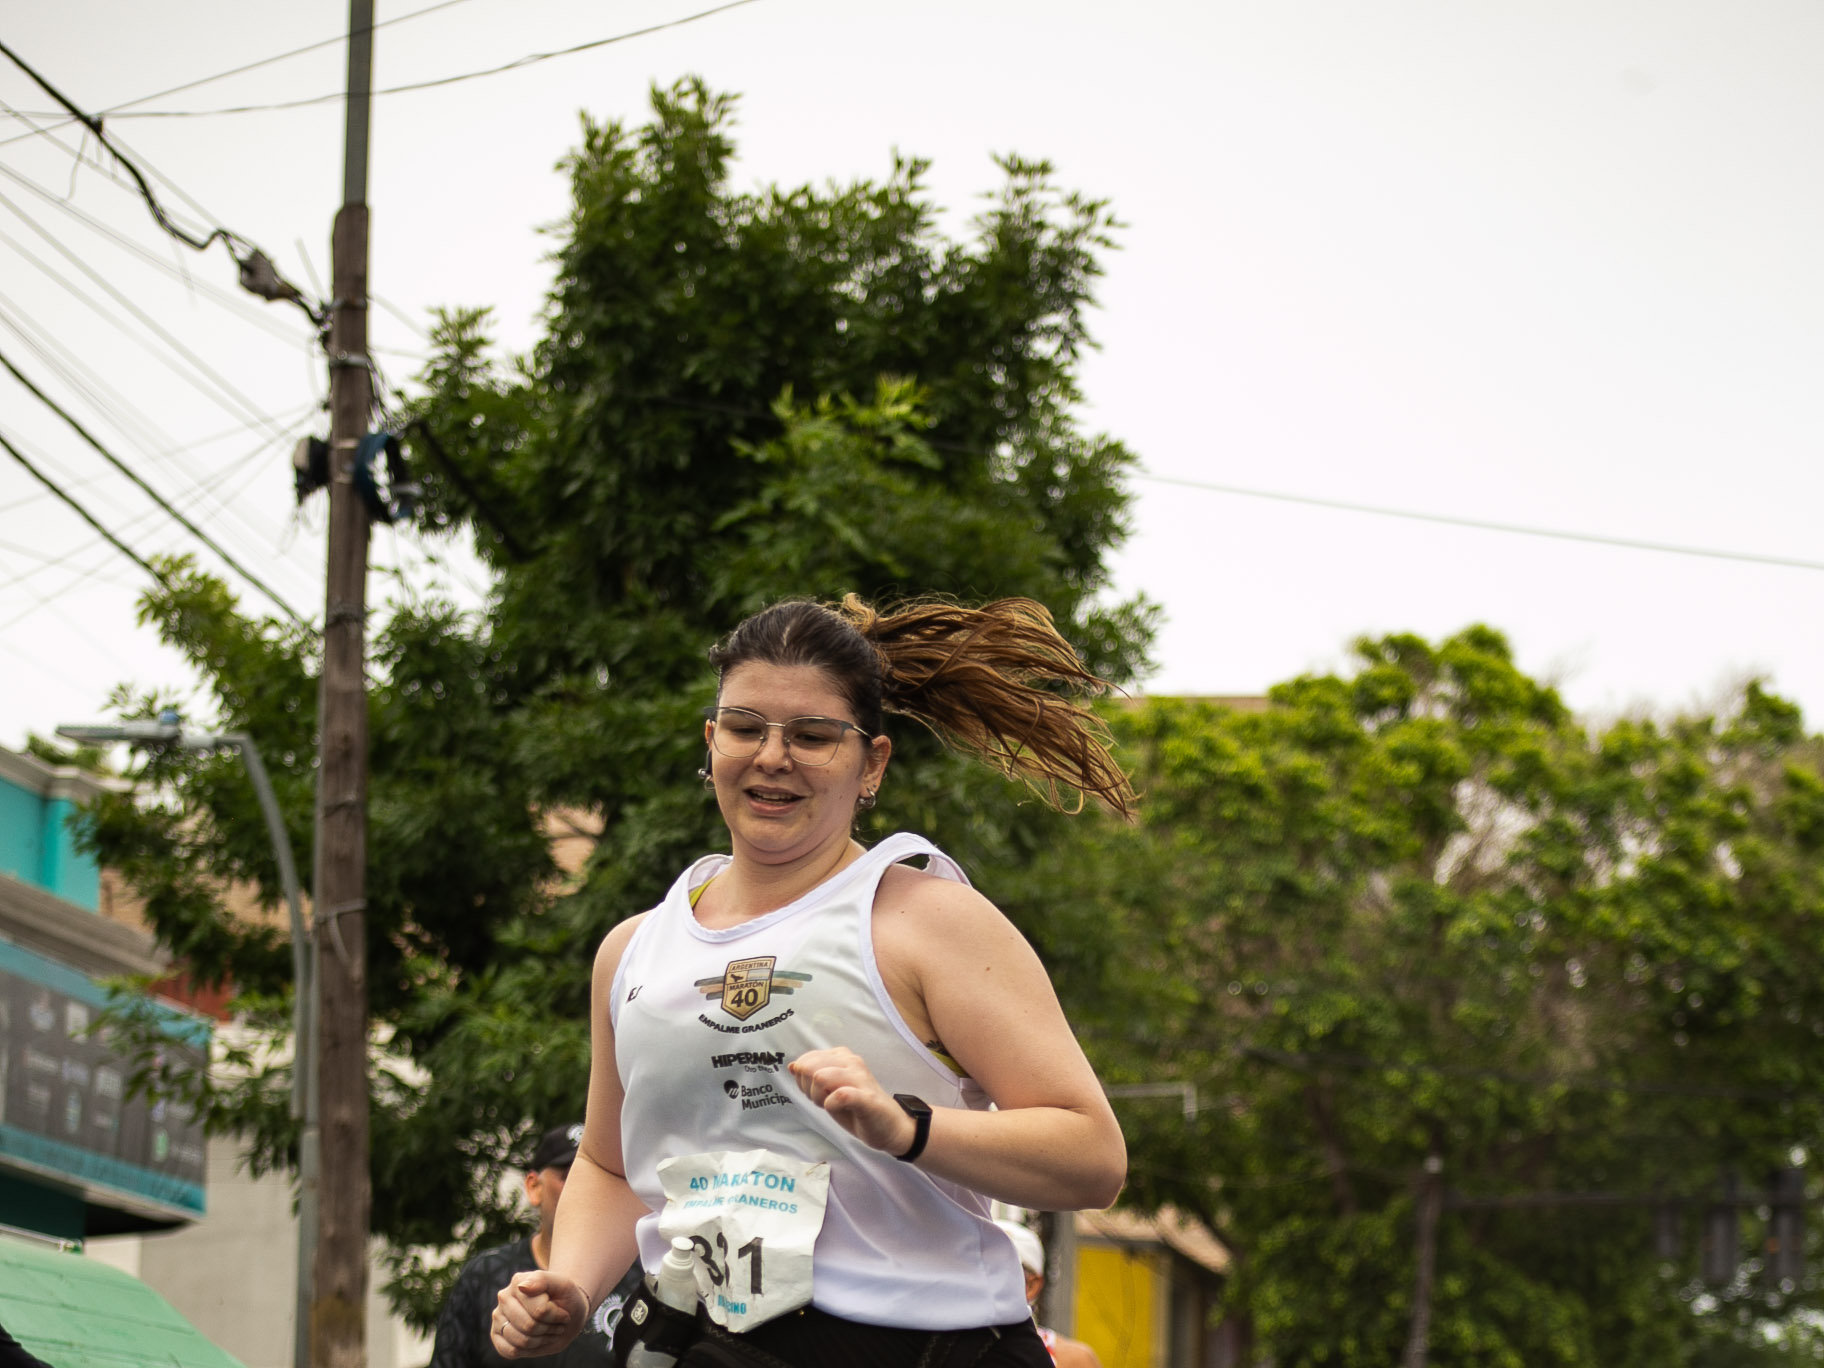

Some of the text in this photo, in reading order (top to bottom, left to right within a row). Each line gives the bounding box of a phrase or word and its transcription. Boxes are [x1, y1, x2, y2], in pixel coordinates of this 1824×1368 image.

[731, 962, 768, 970] ARGENTINA
[731, 988, 759, 1008] 40
[699, 1008, 795, 1034] EMPALME GRANEROS
[741, 1084, 773, 1097] Banco
[712, 1171, 796, 1193] MARATON
